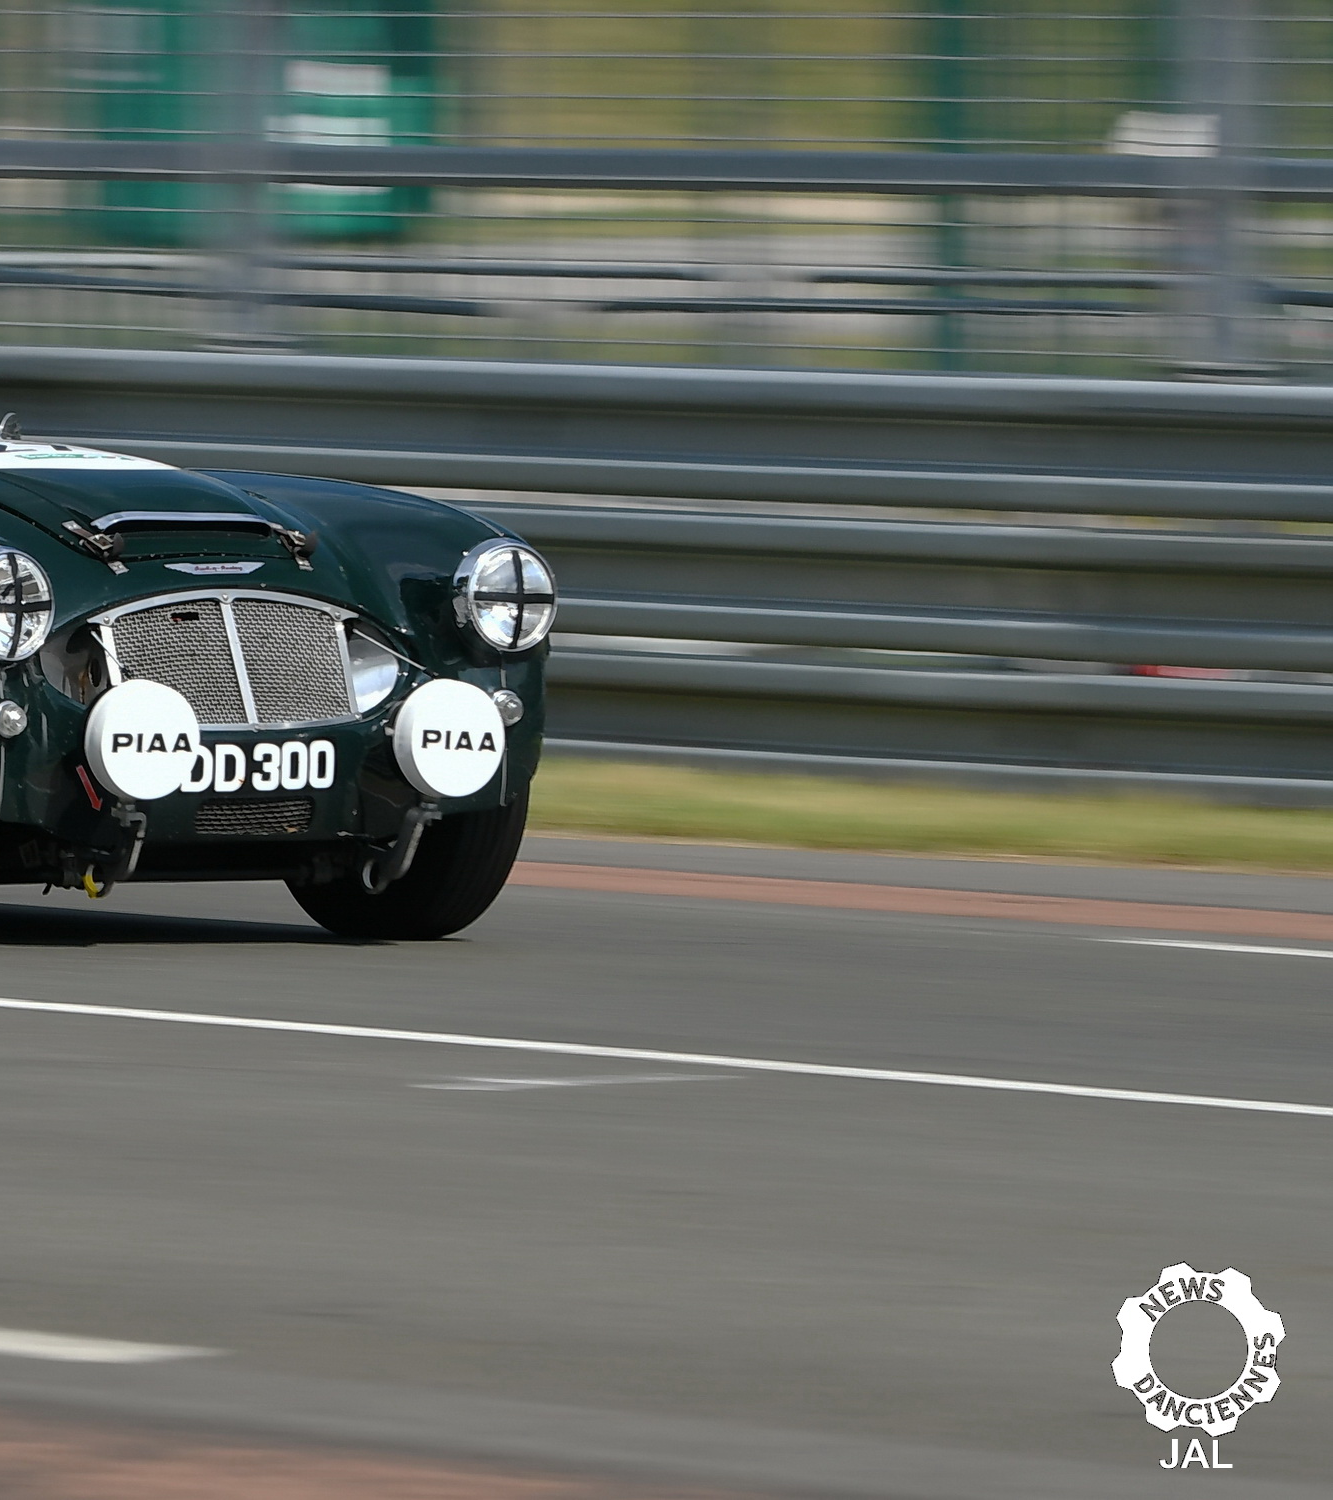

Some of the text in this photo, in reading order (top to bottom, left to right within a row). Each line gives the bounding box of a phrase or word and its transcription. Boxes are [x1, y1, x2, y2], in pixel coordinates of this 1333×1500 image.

[112, 732, 193, 753] PIAA
[421, 729, 497, 753] PIAA
[251, 739, 336, 792] 300
